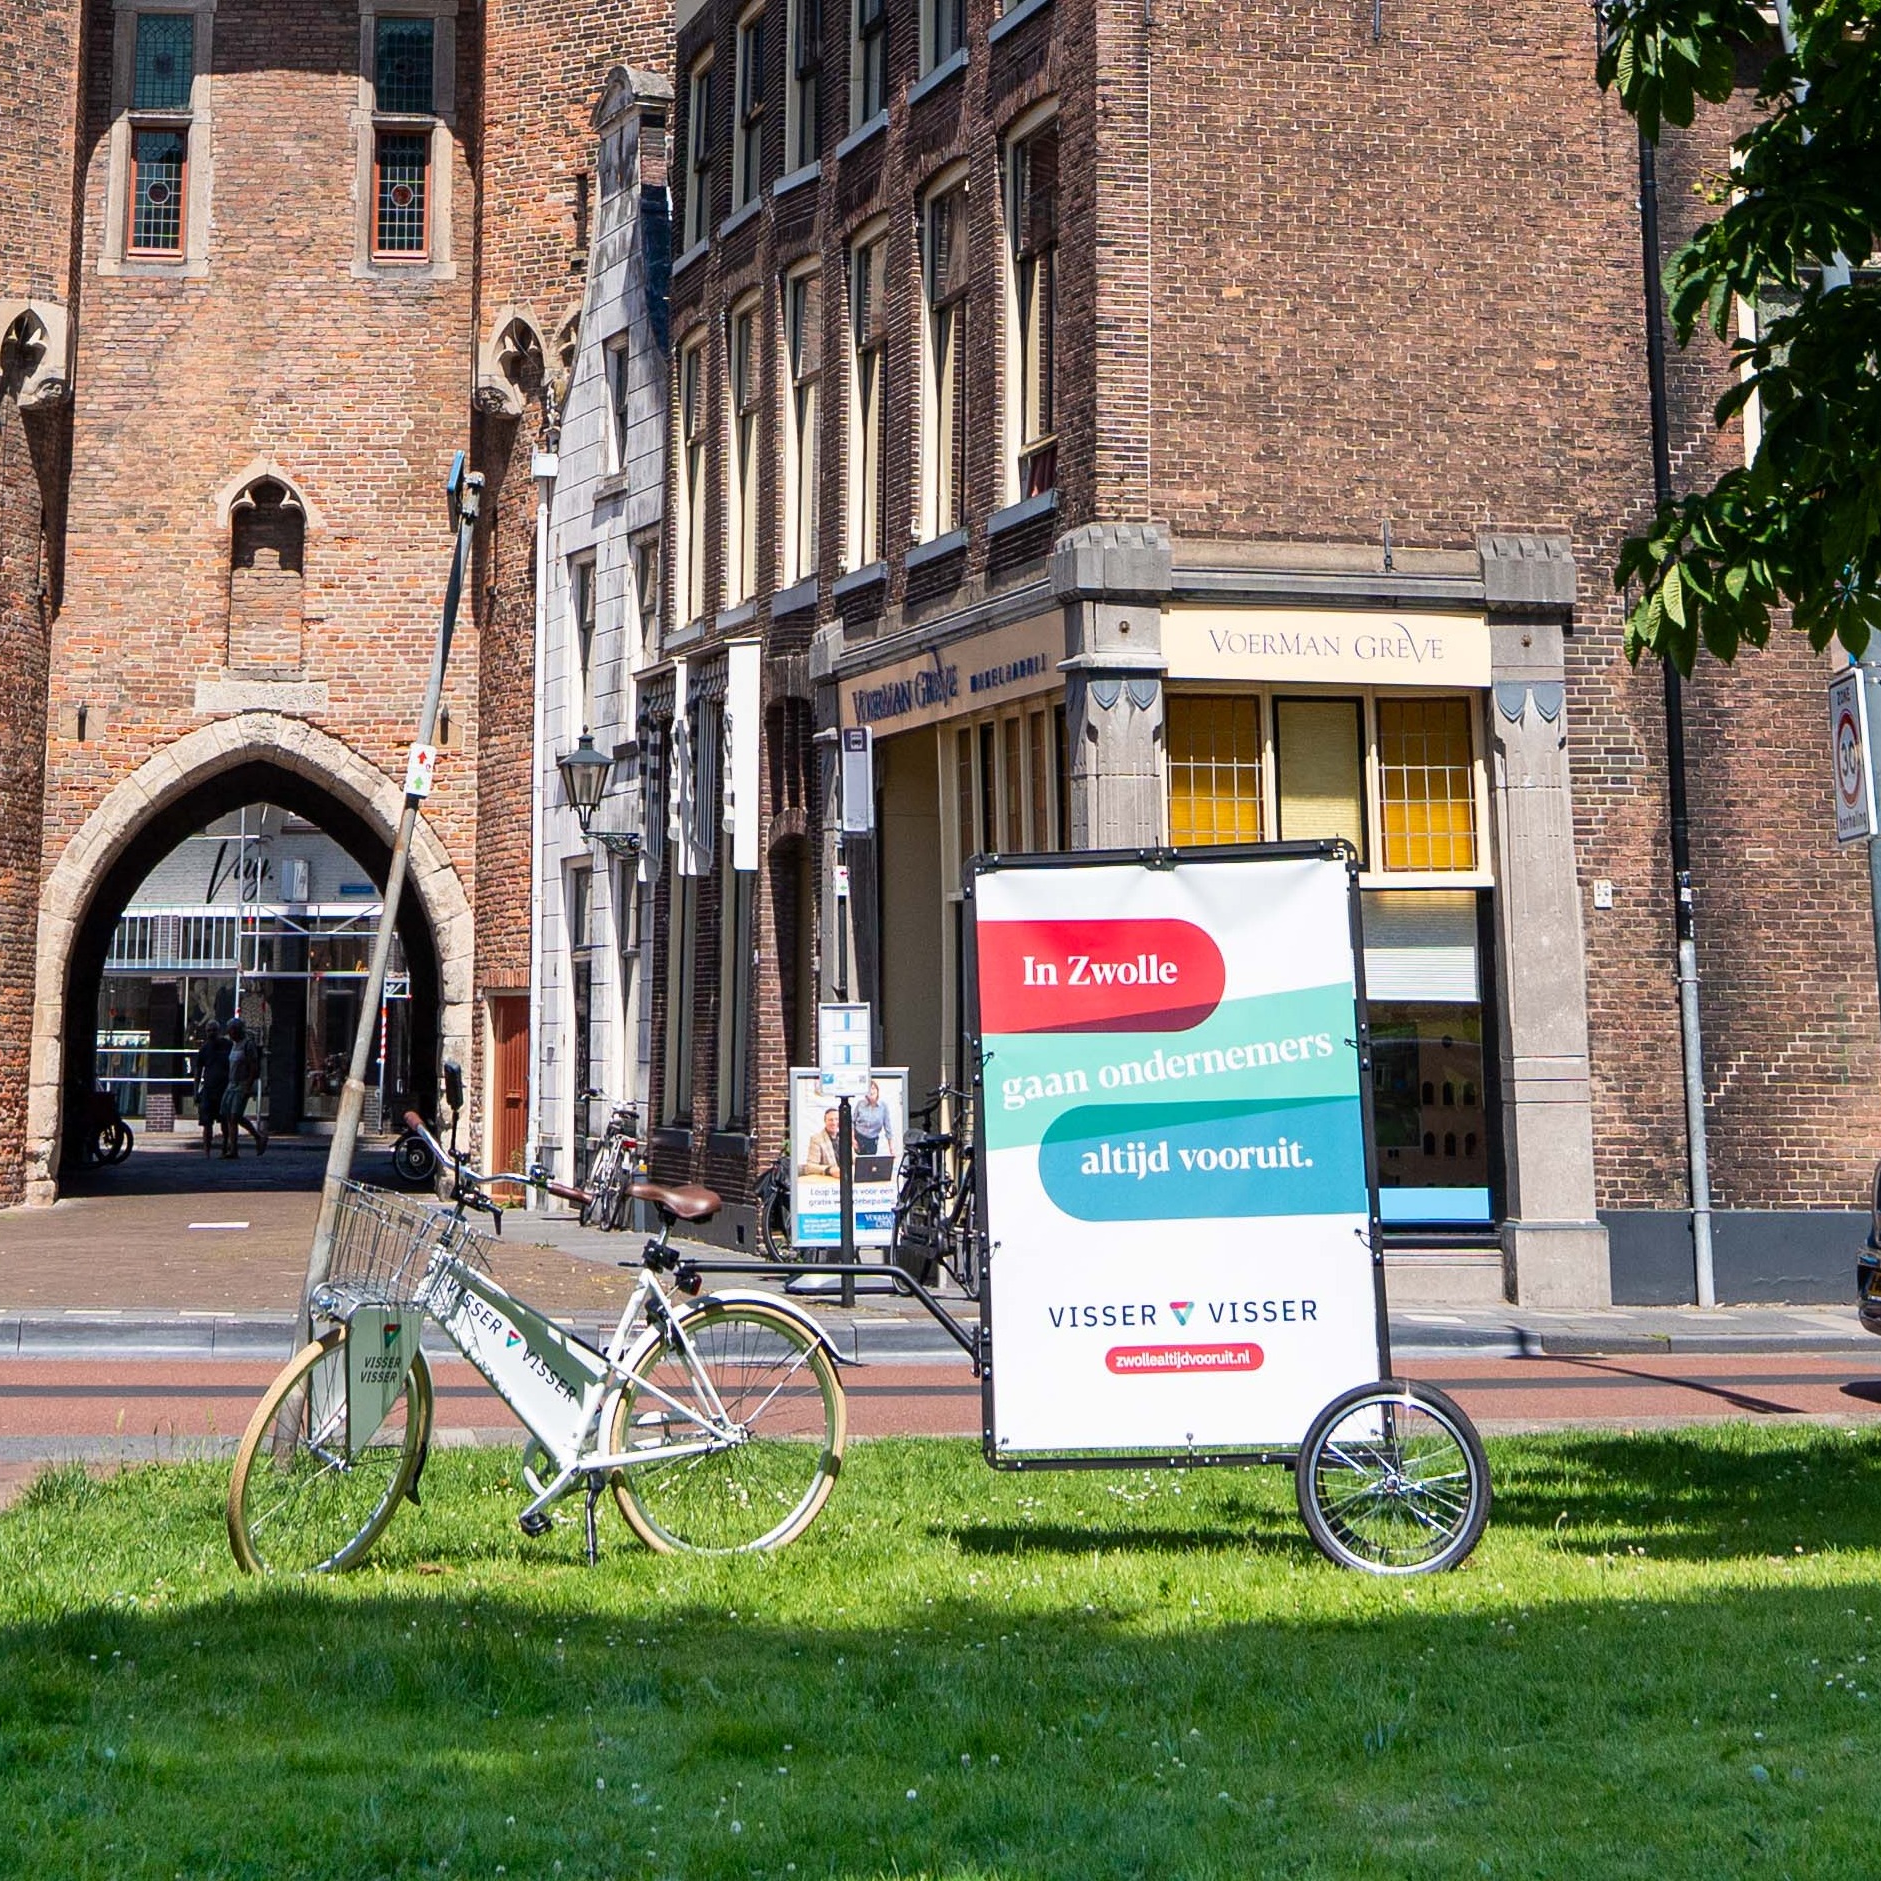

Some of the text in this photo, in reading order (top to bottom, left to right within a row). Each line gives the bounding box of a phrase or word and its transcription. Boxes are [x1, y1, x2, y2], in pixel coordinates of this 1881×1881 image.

[1209, 621, 1444, 664] VOERMAN GREVE
[1841, 739, 1857, 777] 30
[1022, 953, 1178, 986] In Zwolle
[1001, 1032, 1335, 1111] gaan ondernemers
[1080, 1137, 1315, 1181] altijd vooruit.
[1048, 1299, 1318, 1328] VISSER VISSER
[448, 1279, 577, 1402] VISSER VISSER
[364, 1356, 402, 1368] VISSER
[1115, 1349, 1251, 1369] zwollealtijdvooruit.nl
[360, 1371, 398, 1384] VISSER
